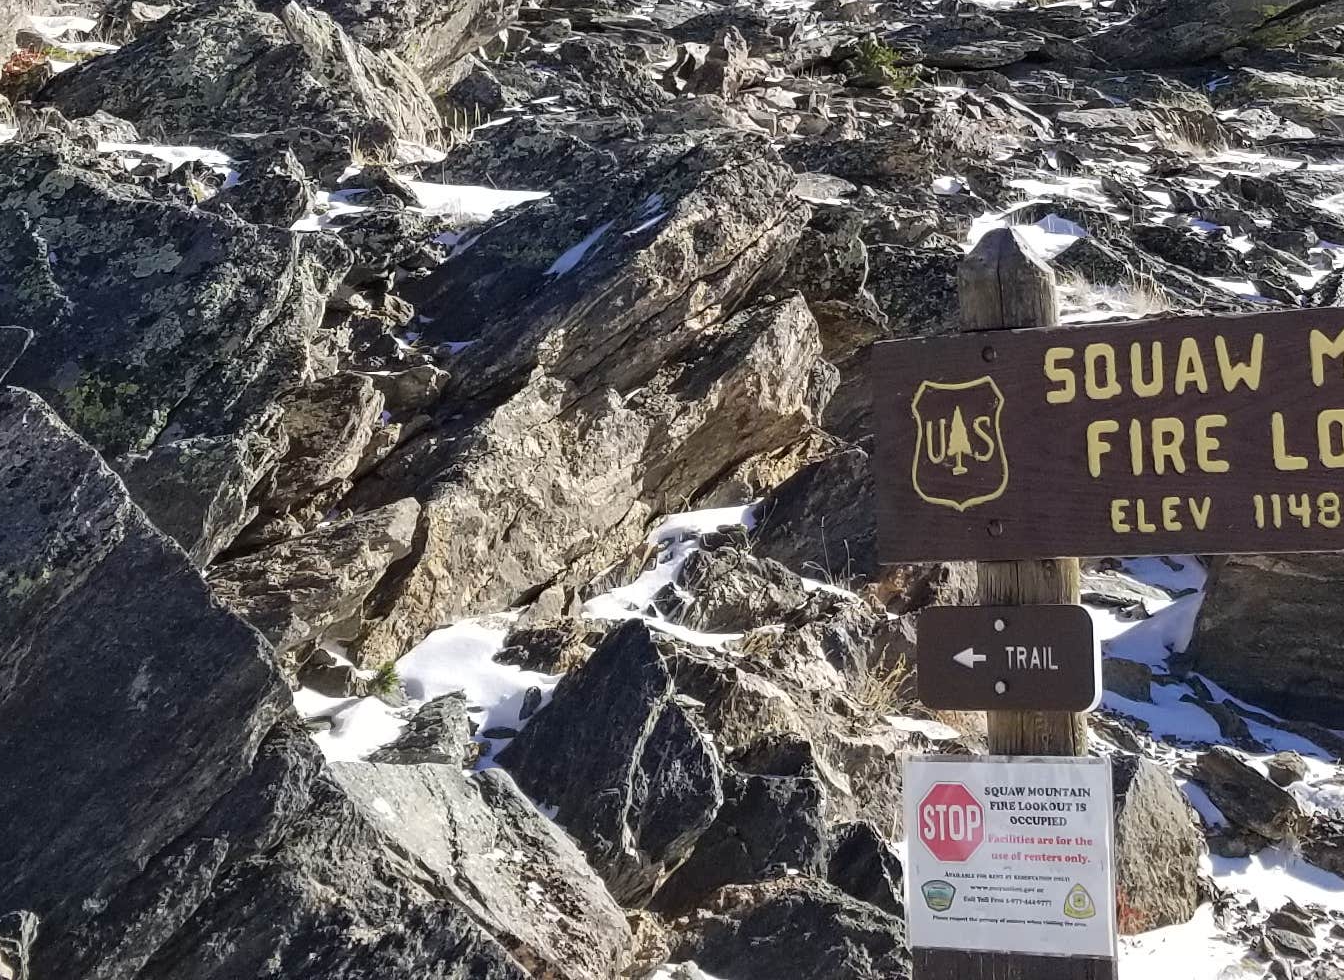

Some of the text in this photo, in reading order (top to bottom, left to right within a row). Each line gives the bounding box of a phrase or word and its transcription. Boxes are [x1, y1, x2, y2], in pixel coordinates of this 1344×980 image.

[1044, 332, 1264, 404] SQUAW
[1086, 413, 1231, 478] FIRE
[1110, 495, 1212, 533] ELEV
[1005, 646, 1059, 670] TRAIL
[984, 786, 1092, 798] SQUAW MOUNTAIN
[989, 800, 1087, 812] FIRE LOOKOUT IS
[923, 804, 981, 841] STOP
[1009, 815, 1068, 827] OCCUPIED
[988, 834, 1093, 846] Facilities are for the
[991, 851, 1092, 865] use of renters only.
